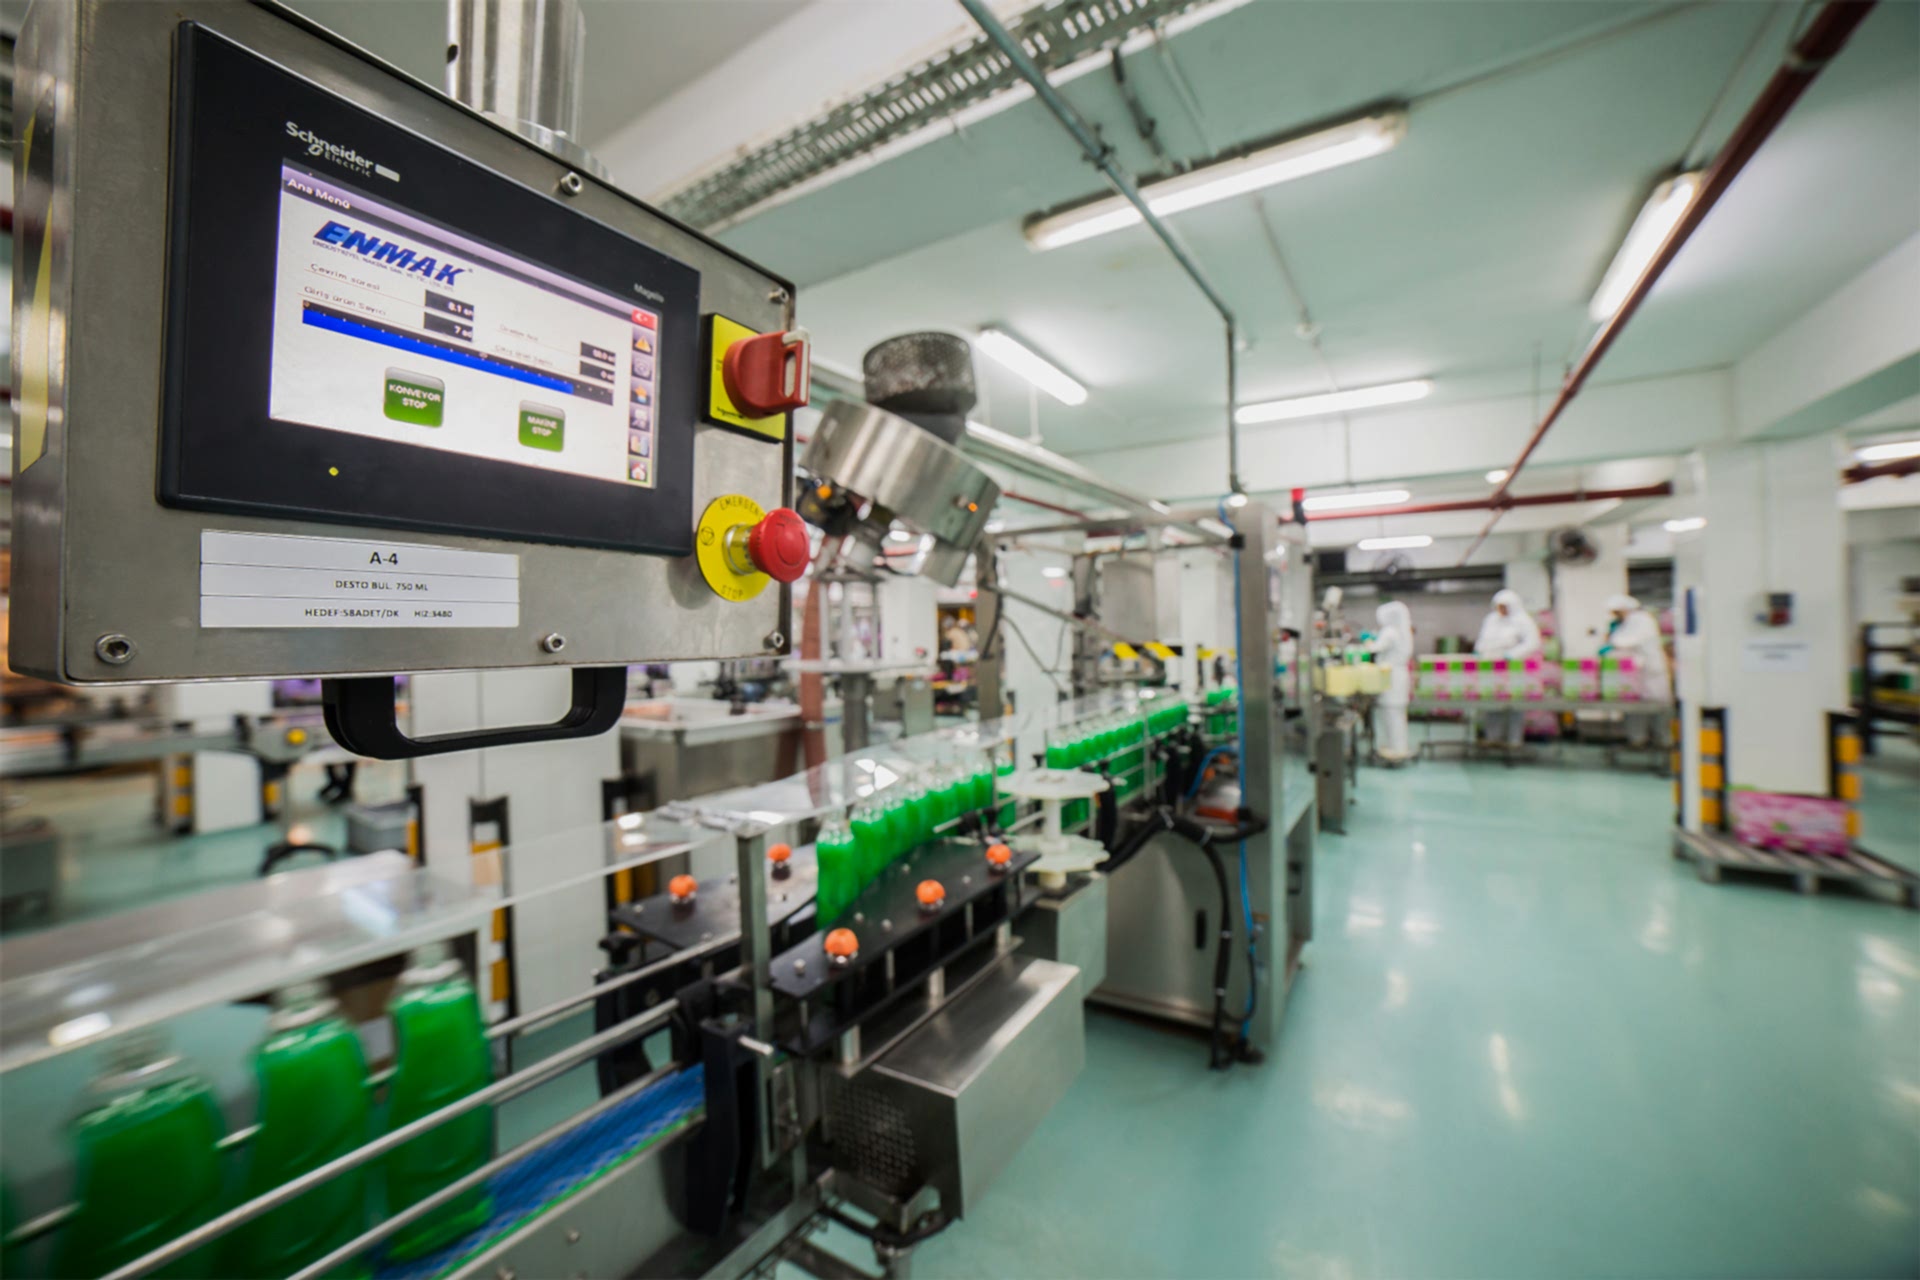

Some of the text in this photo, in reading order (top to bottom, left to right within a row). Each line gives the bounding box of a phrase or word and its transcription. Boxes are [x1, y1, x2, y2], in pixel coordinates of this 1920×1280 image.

[286, 121, 374, 170] Schneider
[324, 150, 372, 178] Electric
[287, 178, 314, 195] Ana
[314, 220, 465, 286] ENMAK
[388, 384, 441, 402] KONVEYOR
[402, 397, 427, 409] STOP
[369, 552, 398, 565] A-4
[335, 580, 369, 590] DESTO
[371, 581, 392, 590] BUL.
[396, 583, 413, 591] 750
[721, 585, 743, 599] STOP
